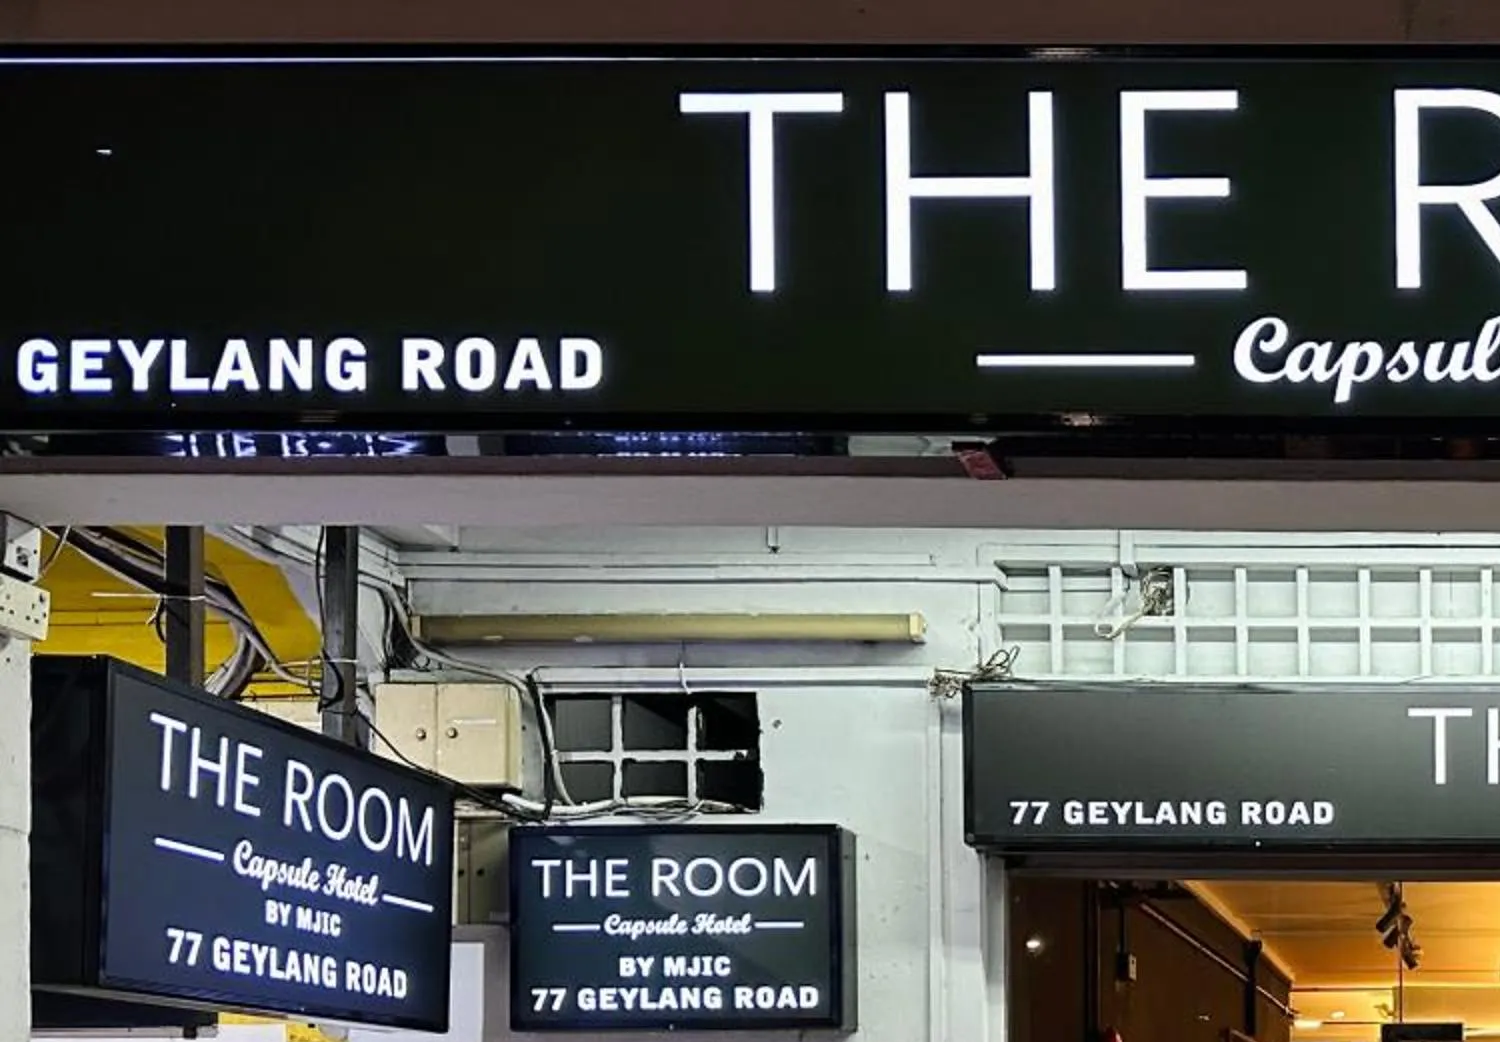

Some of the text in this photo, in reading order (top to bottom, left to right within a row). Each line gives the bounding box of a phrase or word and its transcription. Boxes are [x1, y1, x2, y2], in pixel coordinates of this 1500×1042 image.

[679, 89, 1249, 293] THE
[16, 336, 604, 394] GEYLANG ROAD
[150, 711, 434, 866] THE ROOM
[1009, 799, 1336, 826] 77 GEYLANG ROAD
[232, 839, 379, 906] Capsule Hotel
[531, 857, 818, 898] THE ROOM
[265, 899, 342, 937] BY MJIC
[603, 913, 752, 940] Capsule Hotel
[166, 927, 408, 999] 77 GEYLANG ROAD
[619, 956, 732, 977] BY MJIC
[531, 986, 819, 1011] 77 GEYLANG ROAD
